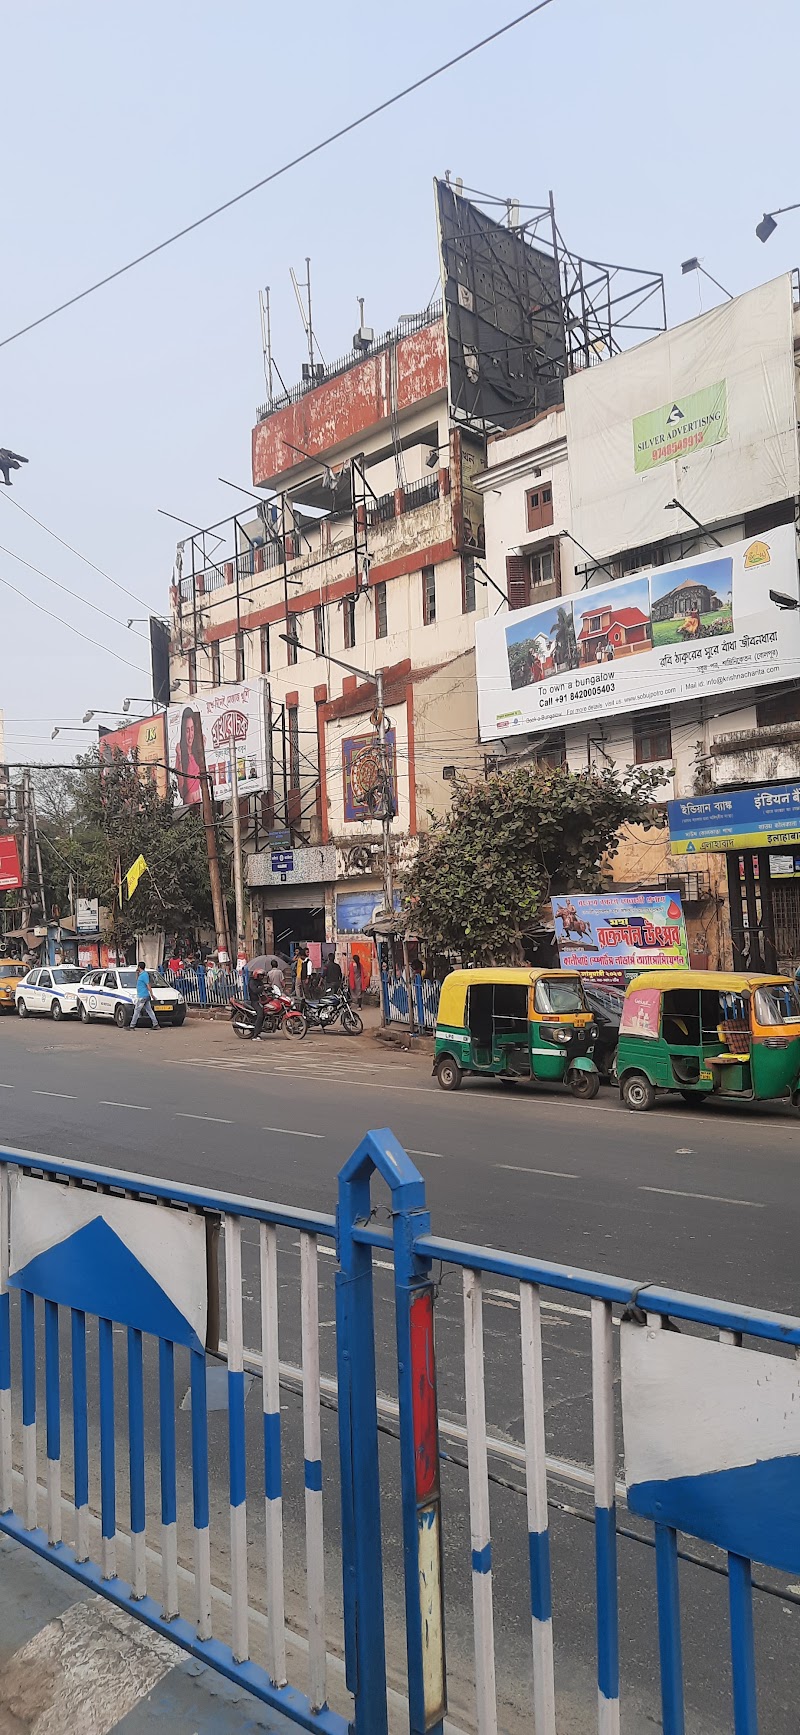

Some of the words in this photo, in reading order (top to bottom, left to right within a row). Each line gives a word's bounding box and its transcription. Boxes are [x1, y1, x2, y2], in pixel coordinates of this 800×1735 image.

[637, 433, 665, 452] SILVER
[666, 410, 722, 441] ADVERTISING
[659, 654, 673, 667] রবি
[674, 648, 702, 666] ঠাকুরের
[704, 645, 719, 660] সুরে
[721, 639, 737, 652] বাঁধা
[739, 631, 778, 649] জীবনধারা
[538, 686, 548, 696] To
[549, 682, 566, 694] own
[567, 682, 573, 690] a
[575, 671, 615, 688] bungalow
[685, 681, 696, 690] Mail
[539, 697, 553, 708] Call
[555, 693, 568, 705] +91
[570, 683, 616, 701] 8420005403
[566, 708, 575, 716] For
[575, 706, 587, 714] more
[754, 792, 791, 810] इंडियन
[699, 839, 735, 852] এলাহাবাদ
[767, 831, 800, 844] इलाहाबा
[596, 925, 642, 949] রক্তদান
[643, 920, 681, 947] উৎসব
